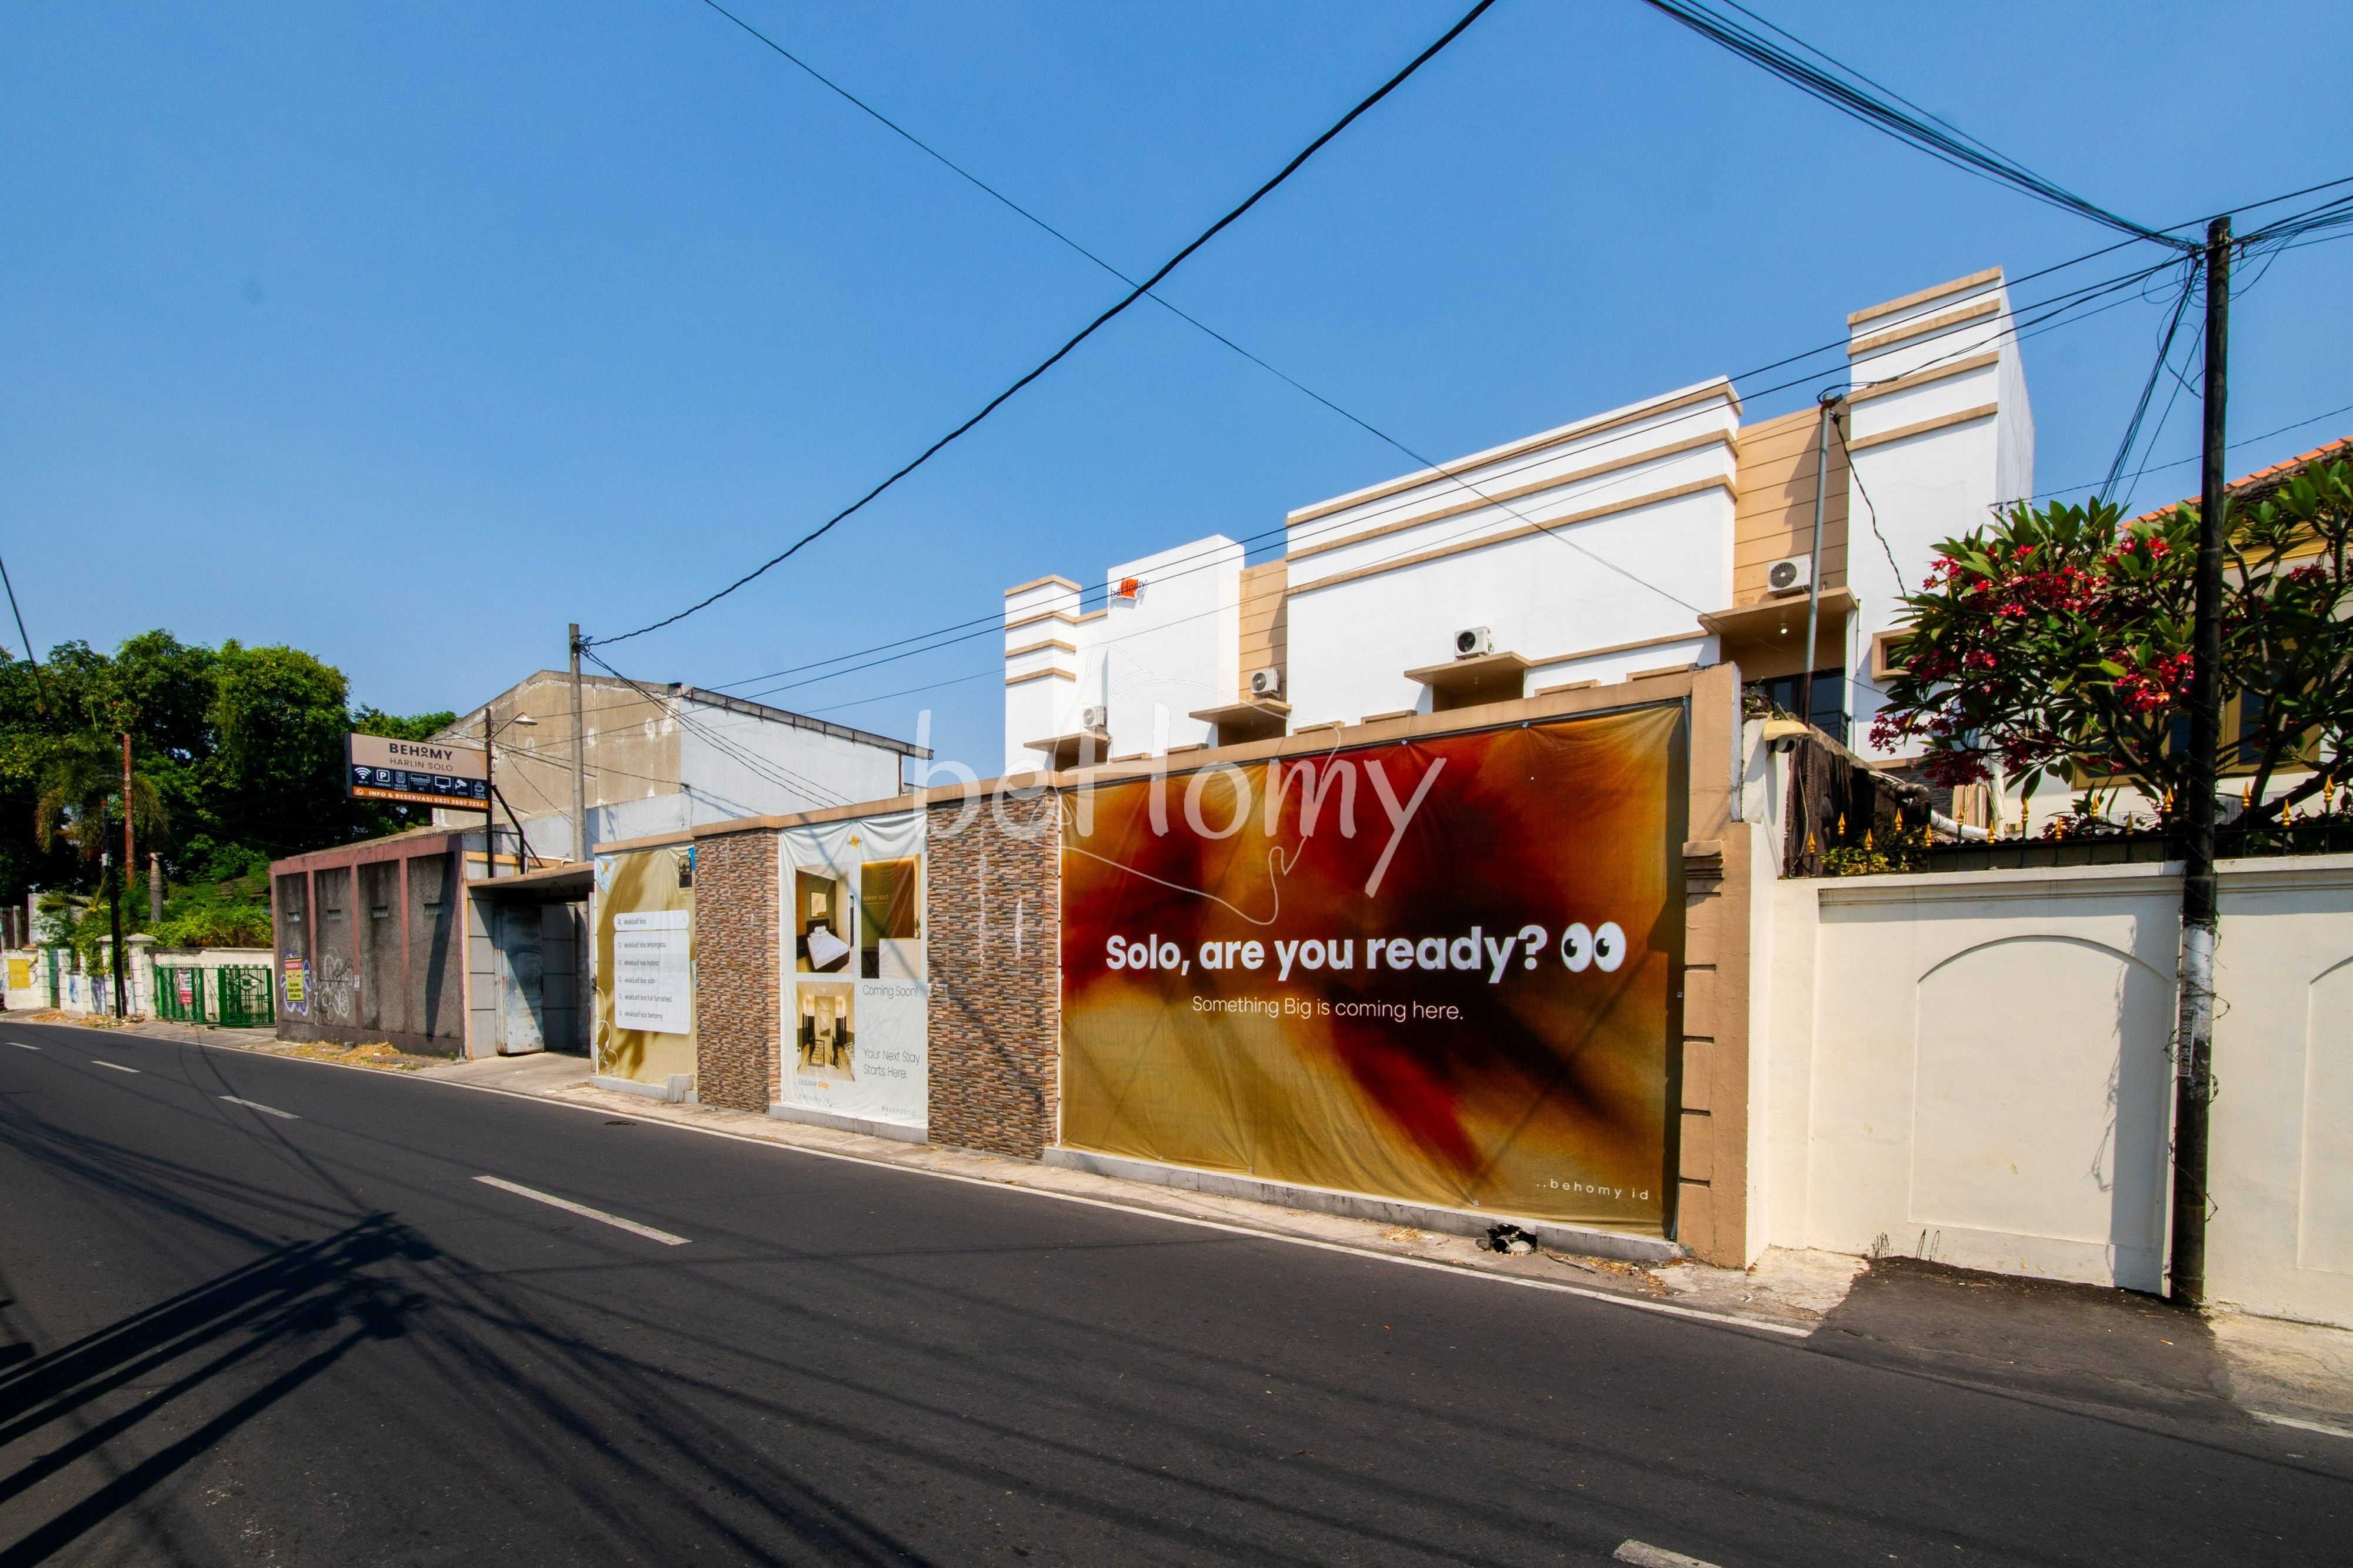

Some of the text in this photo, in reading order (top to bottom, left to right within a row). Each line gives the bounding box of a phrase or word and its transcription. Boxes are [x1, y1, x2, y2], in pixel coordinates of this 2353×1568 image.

[1111, 578, 1147, 598] beHomy
[389, 743, 453, 760] BEHOMY
[390, 758, 453, 772] HARLIN SOLO
[395, 793, 432, 802] RESERVASI
[1106, 925, 1548, 983] Solo, are you ready?
[863, 985, 918, 999] Coming Soon!
[1193, 996, 1464, 1022] Something Big is coming here.
[864, 1048, 921, 1066] Your Next Stay
[864, 1063, 908, 1079] Starts Here.
[818, 1081, 829, 1090] Stay
[882, 1106, 915, 1116] #koshybrid
